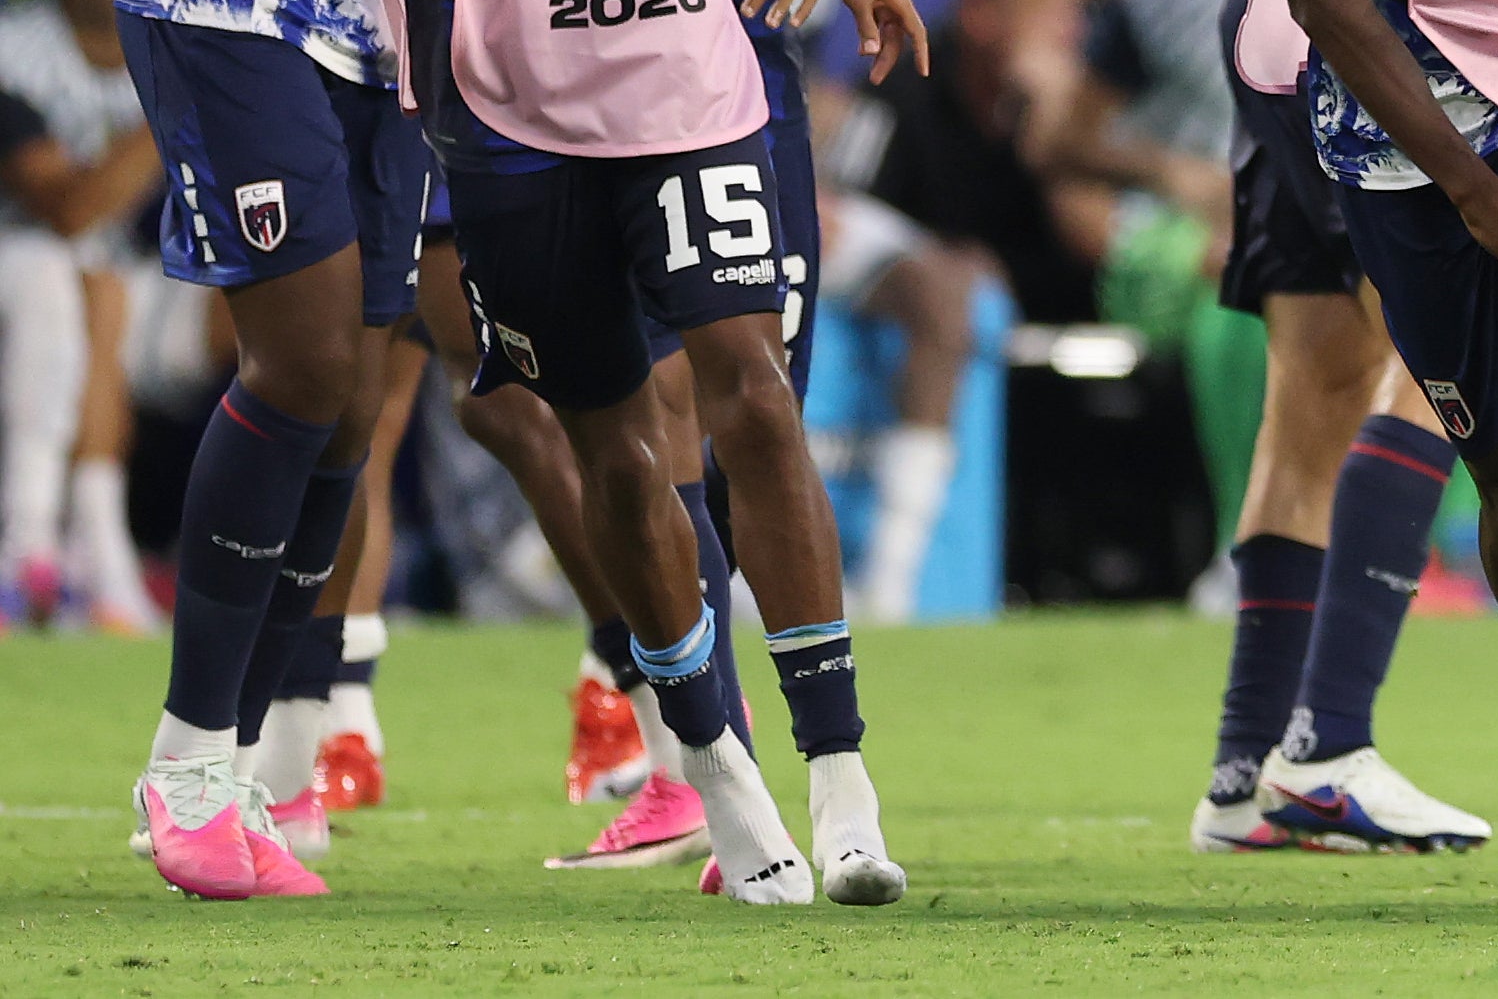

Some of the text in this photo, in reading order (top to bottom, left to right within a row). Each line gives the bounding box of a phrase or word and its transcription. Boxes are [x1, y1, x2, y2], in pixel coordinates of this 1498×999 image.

[240, 187, 278, 201] FCF
[656, 163, 773, 273] 15
[713, 258, 776, 286] capelli
[745, 276, 776, 286] SPORT
